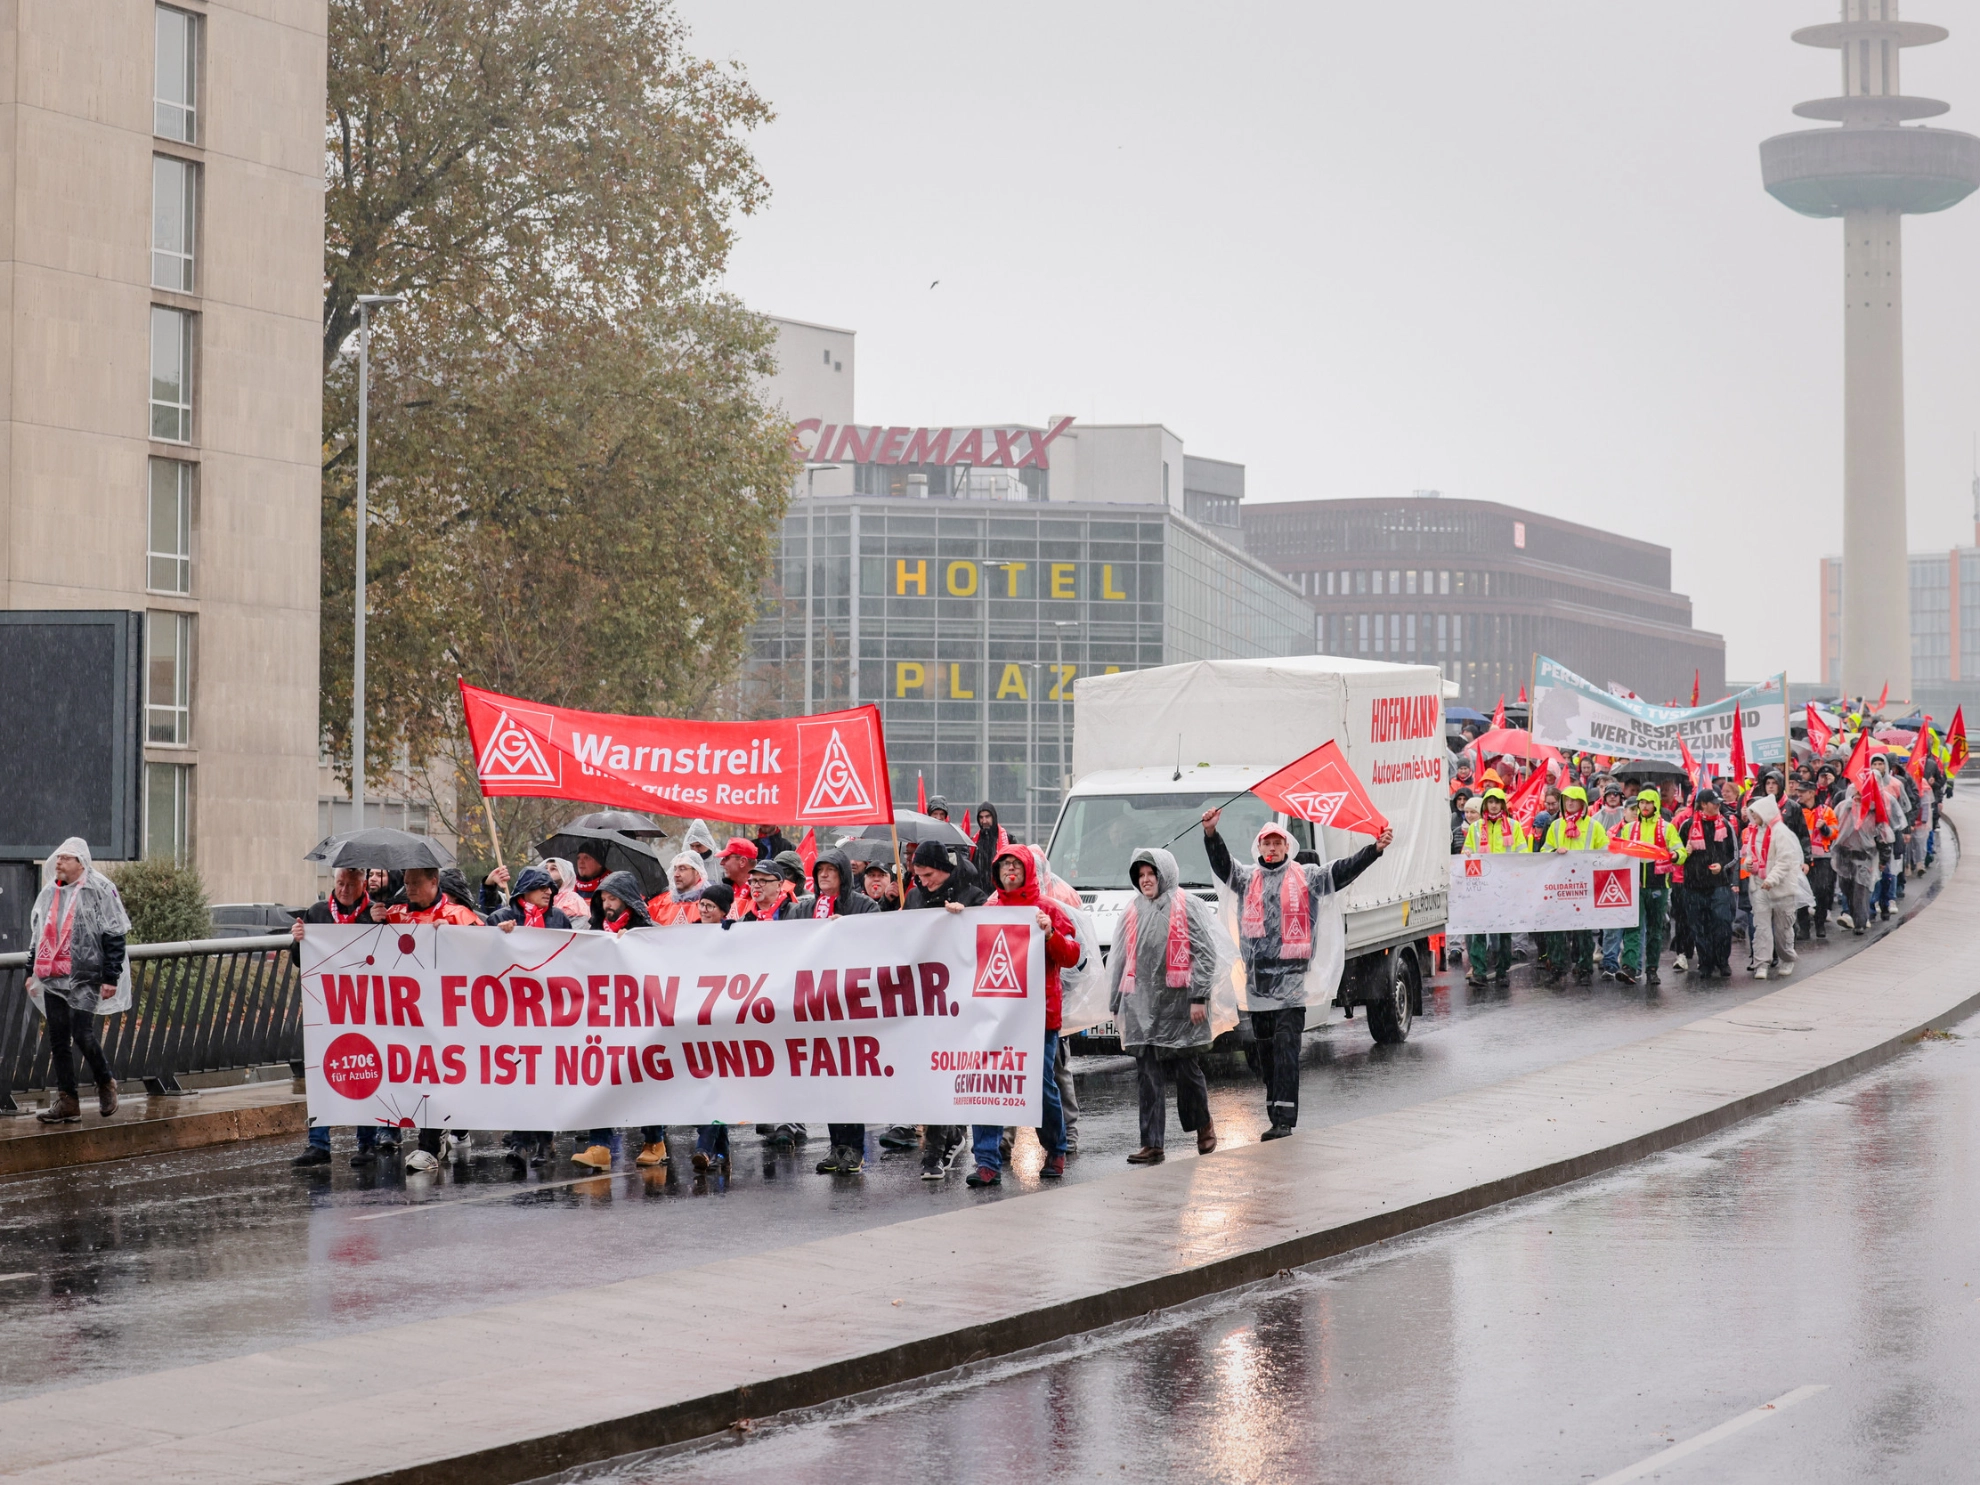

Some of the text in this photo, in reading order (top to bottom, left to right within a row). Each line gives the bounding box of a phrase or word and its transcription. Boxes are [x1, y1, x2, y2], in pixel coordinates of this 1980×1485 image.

[788, 416, 1076, 470] CINEMAXX
[896, 560, 1126, 600] HOTEL
[1371, 694, 1439, 743] HOFFMANN
[1630, 717, 1715, 739] RESPEKT
[571, 732, 783, 775] Warnstreik
[1372, 754, 1441, 785] Autovermietug
[716, 782, 780, 805] Recht
[1544, 881, 1588, 890] SOLIDARITÄT
[1556, 889, 1588, 897] GEWINNT
[320, 962, 960, 1027] WIR FORDERN 7% MEHR.
[387, 1034, 895, 1086] DAS IST NÖTIG UND FAIR.
[931, 1046, 1028, 1072] SOLIDARITÄT
[331, 1069, 379, 1083] für Azubis
[954, 1073, 1027, 1095] GEWINNT
[1002, 1097, 1026, 1107] 2024
